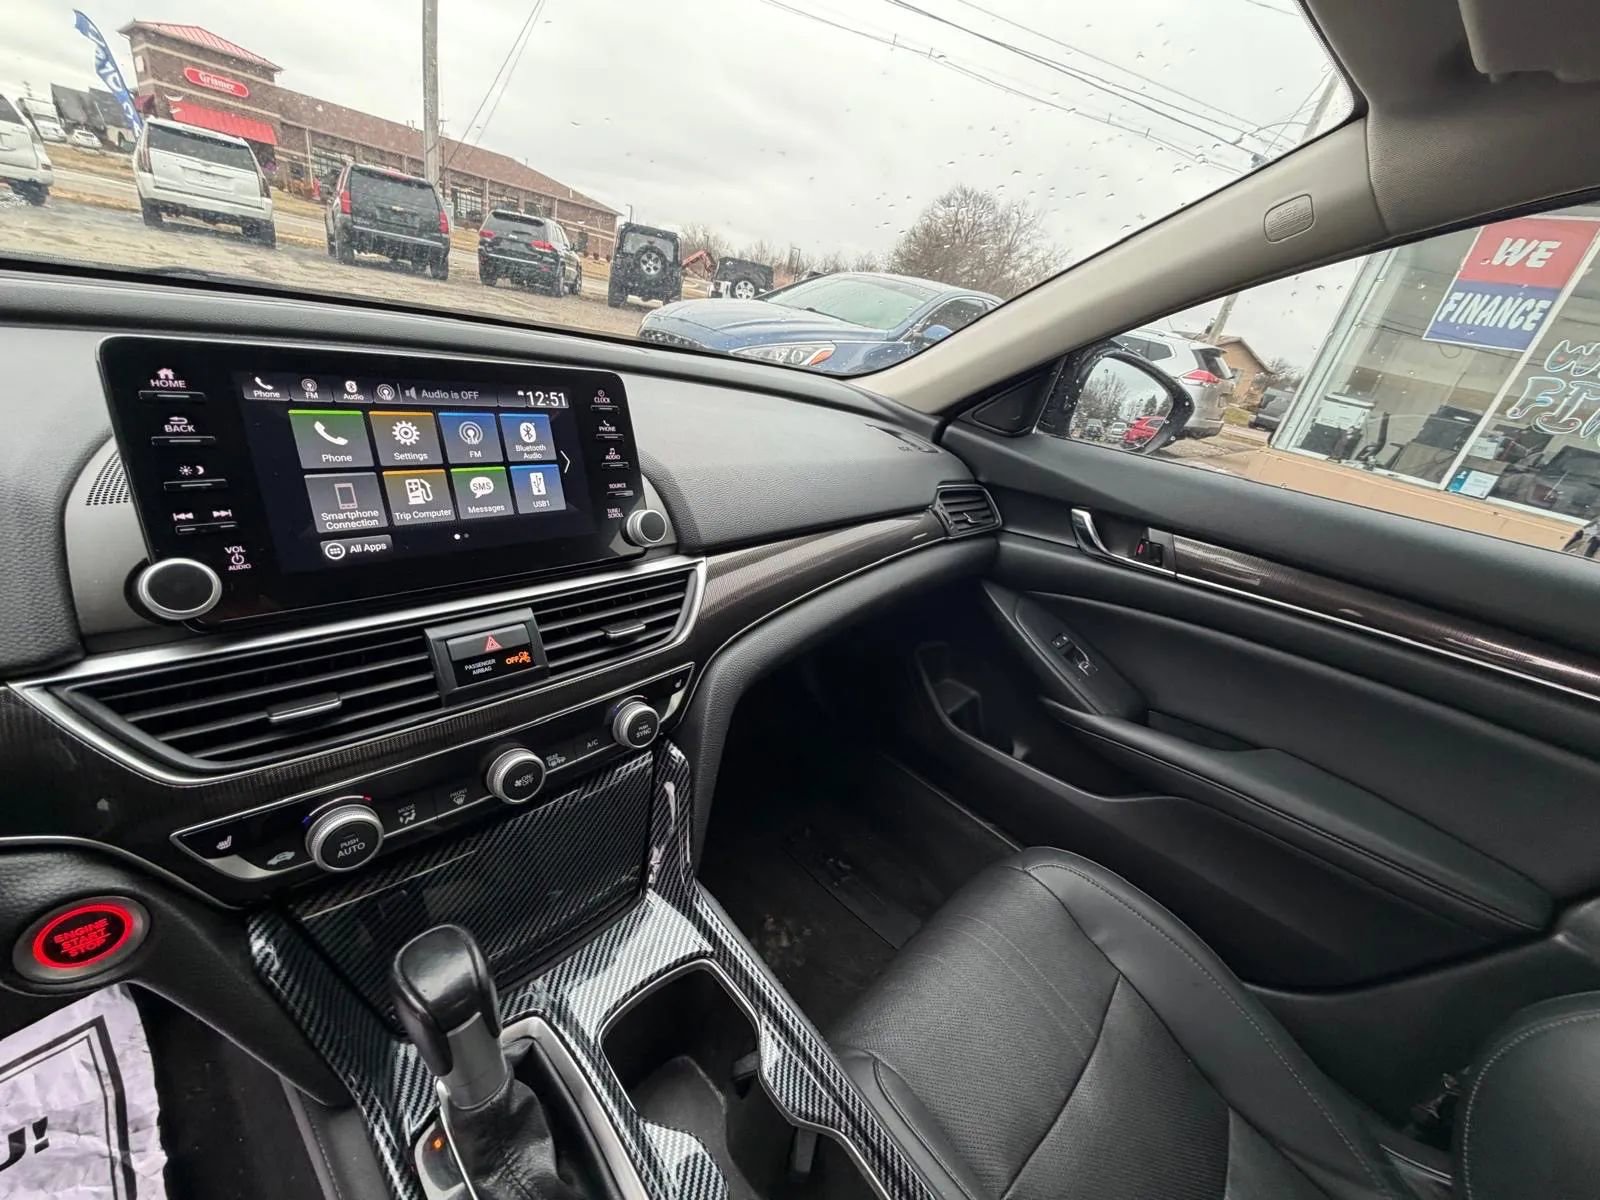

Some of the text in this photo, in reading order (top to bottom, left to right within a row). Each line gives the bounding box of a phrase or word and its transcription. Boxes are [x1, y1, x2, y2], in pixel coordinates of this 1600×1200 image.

[1490, 237, 1561, 268] WE
[1438, 292, 1552, 331] FINANCE
[150, 378, 187, 389] HOME
[253, 390, 281, 398] Phone
[343, 393, 364, 401] Audio
[421, 389, 480, 400] Audio is OFF
[526, 391, 566, 407] 12:51
[164, 424, 196, 433] BACK
[515, 444, 547, 452] Bluetooth
[321, 453, 353, 463] Phone
[394, 451, 428, 462] Settings
[469, 450, 482, 458] FM
[523, 452, 543, 460] Audio
[472, 480, 492, 491] SMS
[468, 503, 505, 514] Messages
[532, 500, 550, 508] USB1
[321, 508, 379, 521] Smartphone
[395, 508, 452, 521] Trip Computer
[326, 518, 379, 530] Connection
[224, 546, 246, 554] VOL
[349, 541, 387, 554] All Apps
[228, 563, 251, 571] AUDIO
[464, 659, 496, 671] PASSENGER
[505, 655, 520, 665] OFF
[472, 666, 493, 675] AIRBAG
[636, 727, 652, 738] SYNC
[586, 738, 599, 749] A/C
[398, 803, 416, 814] MODE
[340, 837, 359, 849] PUSH
[337, 841, 366, 858] AUTO
[53, 917, 109, 944] ENGINE
[61, 927, 106, 950] START
[68, 938, 106, 957] STOP
